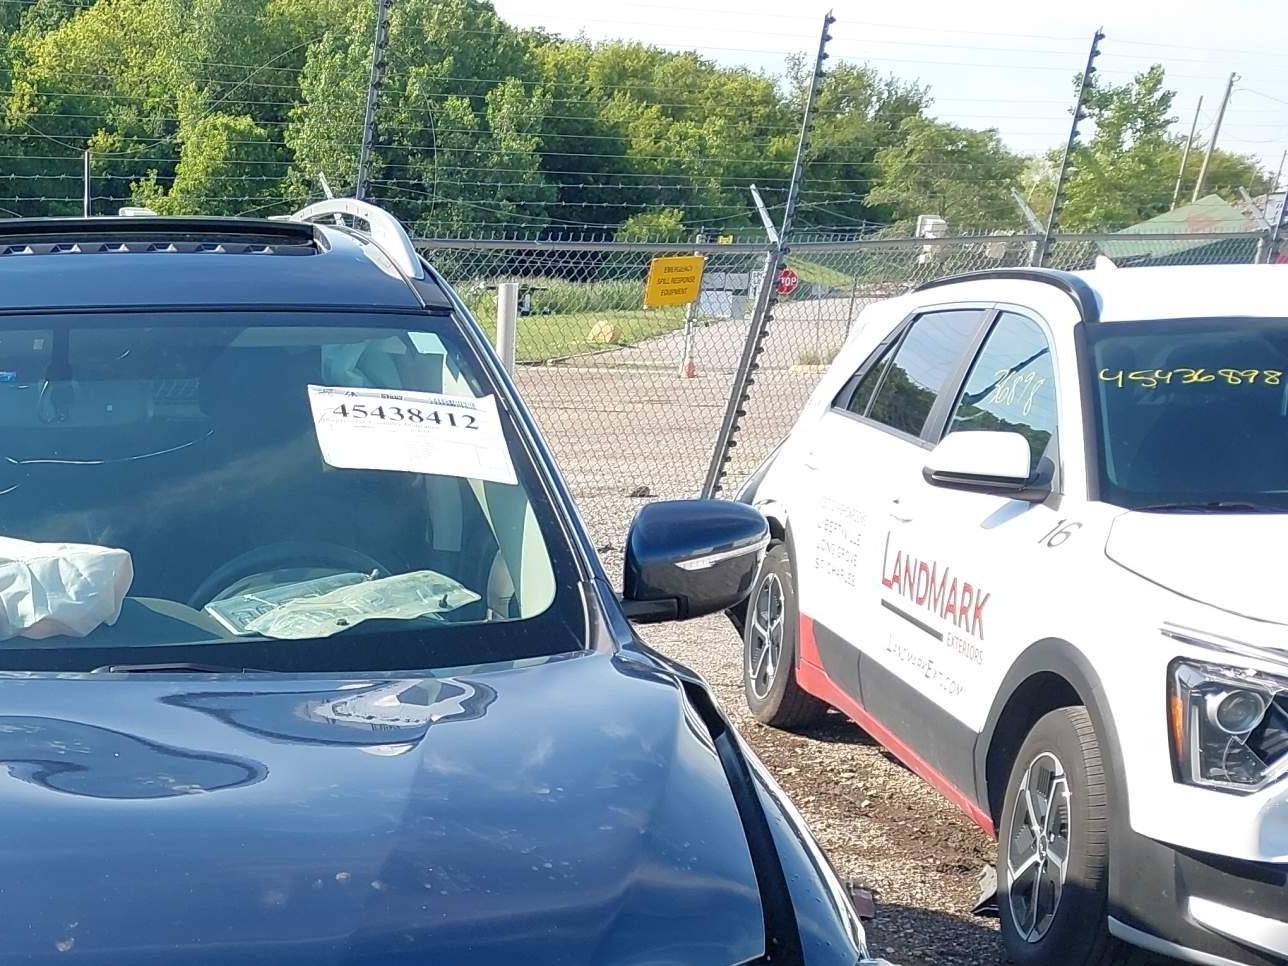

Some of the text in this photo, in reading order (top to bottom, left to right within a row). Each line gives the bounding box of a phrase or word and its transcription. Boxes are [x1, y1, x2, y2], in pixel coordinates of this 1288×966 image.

[1099, 368, 1283, 388] 45436898
[332, 403, 480, 430] 45438412
[1037, 518, 1083, 548] 16
[881, 530, 991, 641] LANDMARK
[946, 632, 985, 665] EXTERIORS
